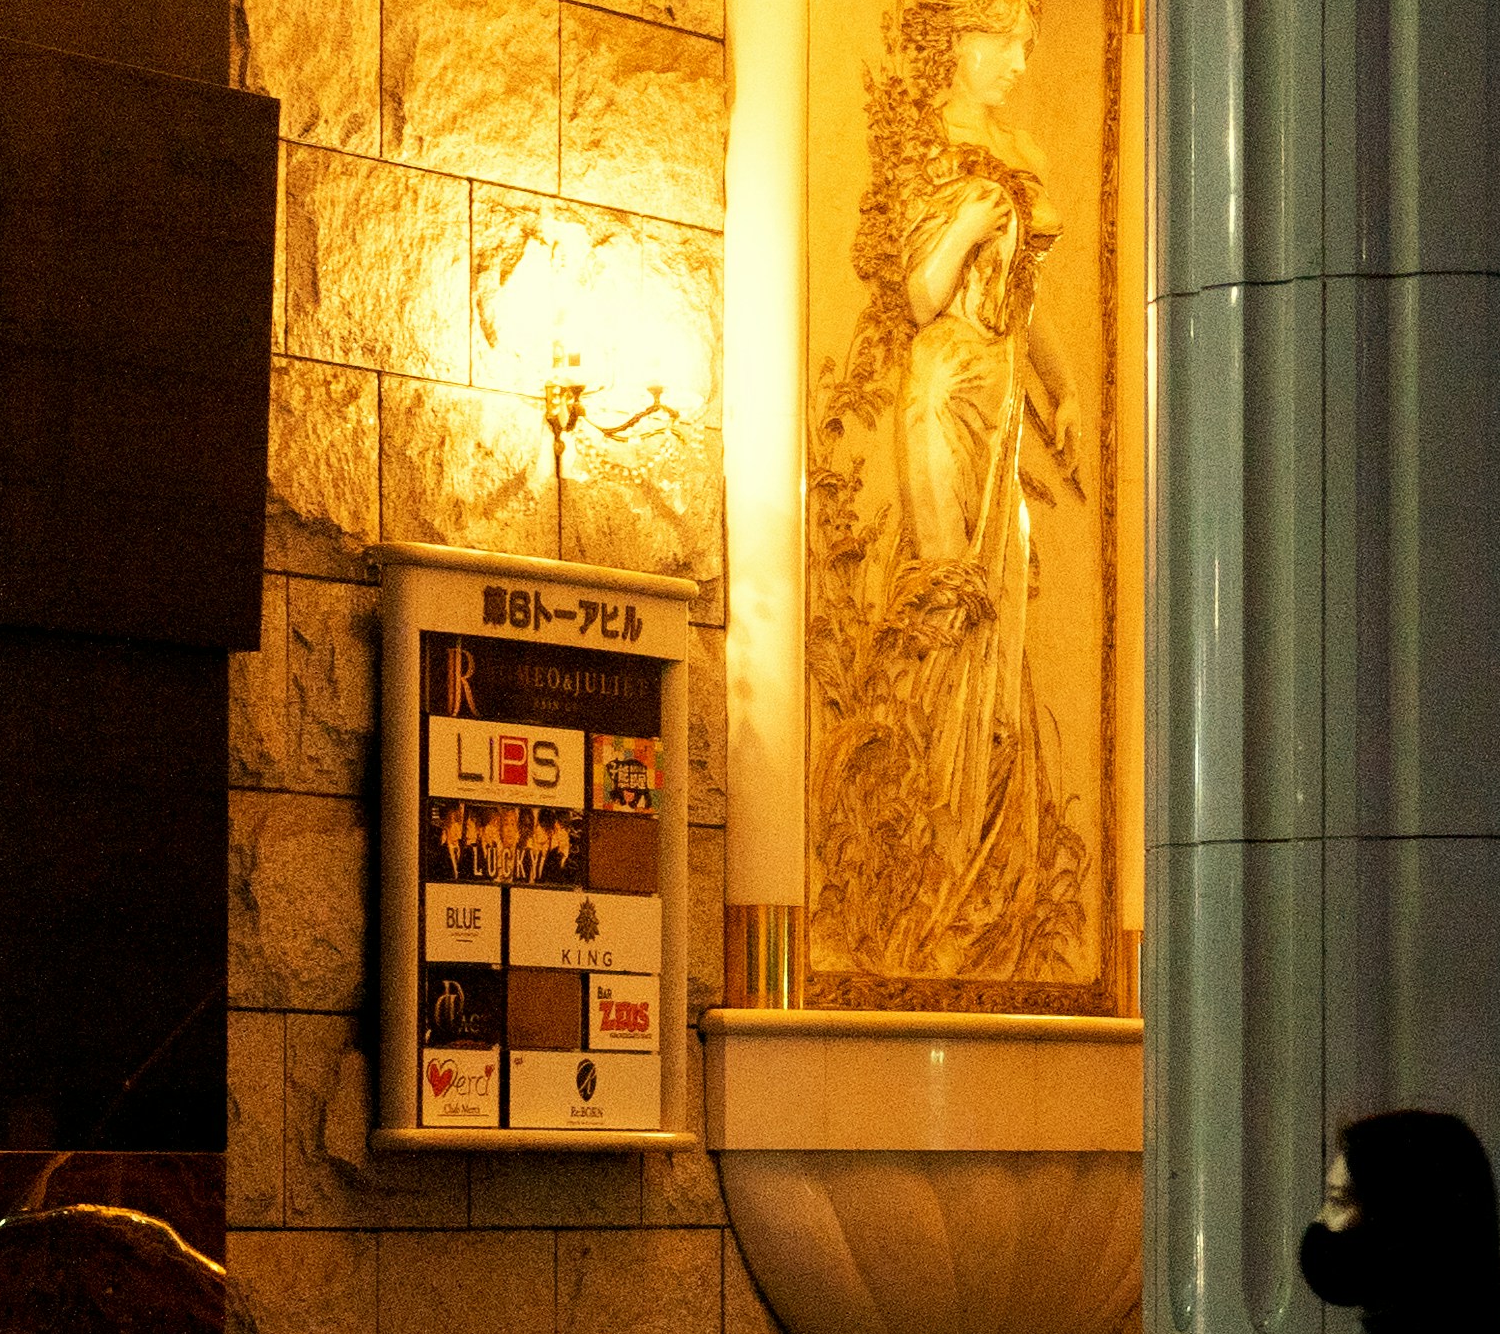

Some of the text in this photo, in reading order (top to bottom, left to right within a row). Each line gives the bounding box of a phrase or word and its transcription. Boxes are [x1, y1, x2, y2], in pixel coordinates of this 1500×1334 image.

[457, 733, 561, 788] LIPS
[473, 844, 546, 881] LUCKY
[446, 907, 482, 929] BLUE
[561, 949, 613, 967] KING
[599, 1000, 650, 1033] ZEUS
